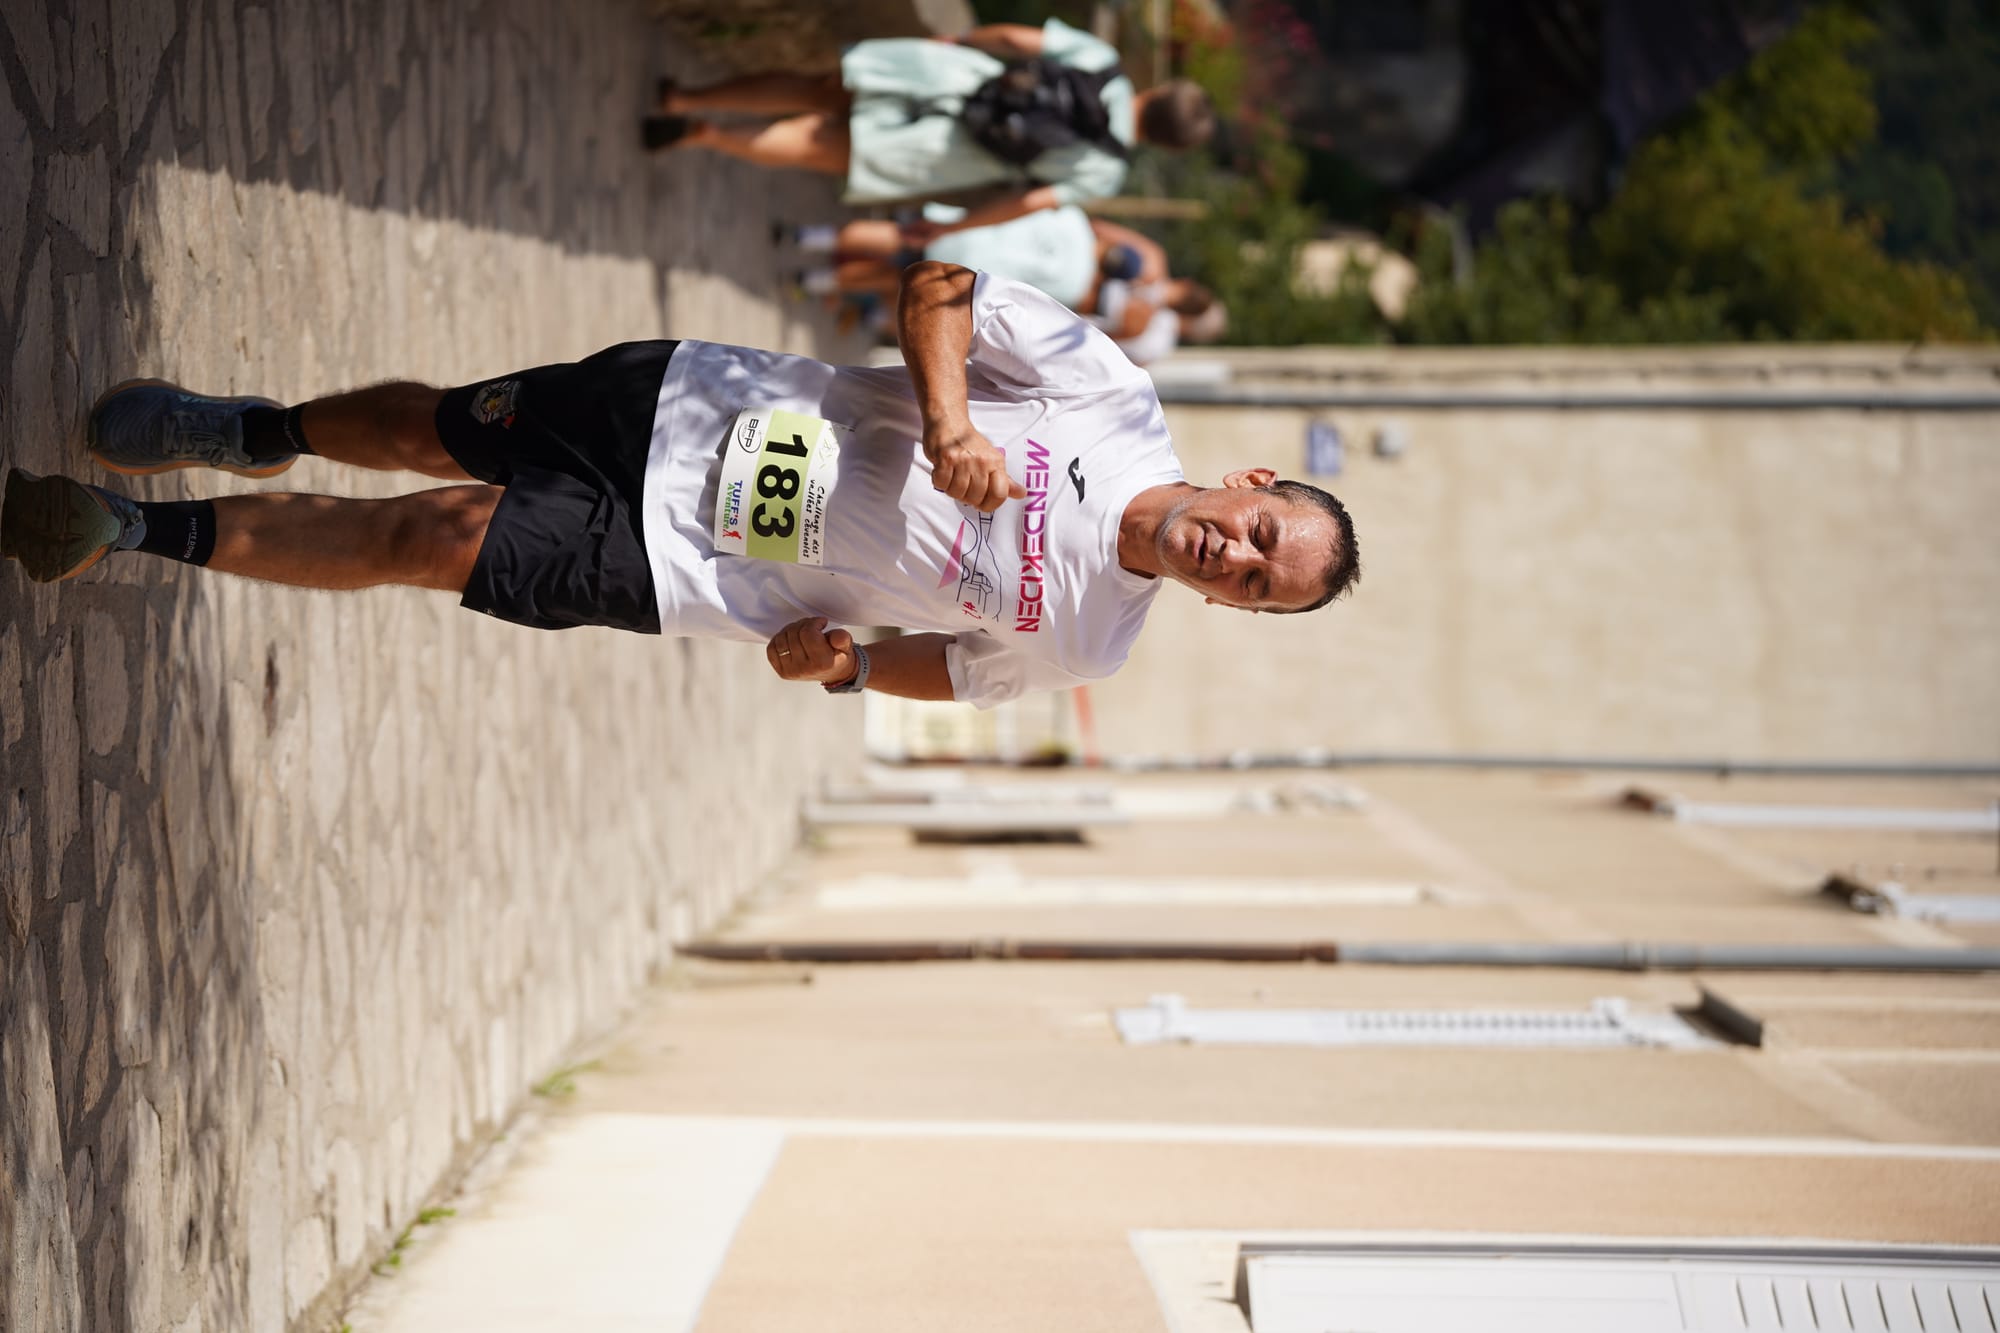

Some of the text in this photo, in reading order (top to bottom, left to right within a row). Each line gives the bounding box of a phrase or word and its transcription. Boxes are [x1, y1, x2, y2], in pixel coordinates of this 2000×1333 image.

[744, 418, 759, 448] BFP
[723, 483, 736, 529] Aventure
[729, 480, 743, 526] TUFF'S
[752, 434, 808, 538] 183
[803, 479, 815, 558] vallées cévenoles
[811, 486, 825, 555] Challenge des
[1015, 438, 1050, 632] MENDEKIDEN
